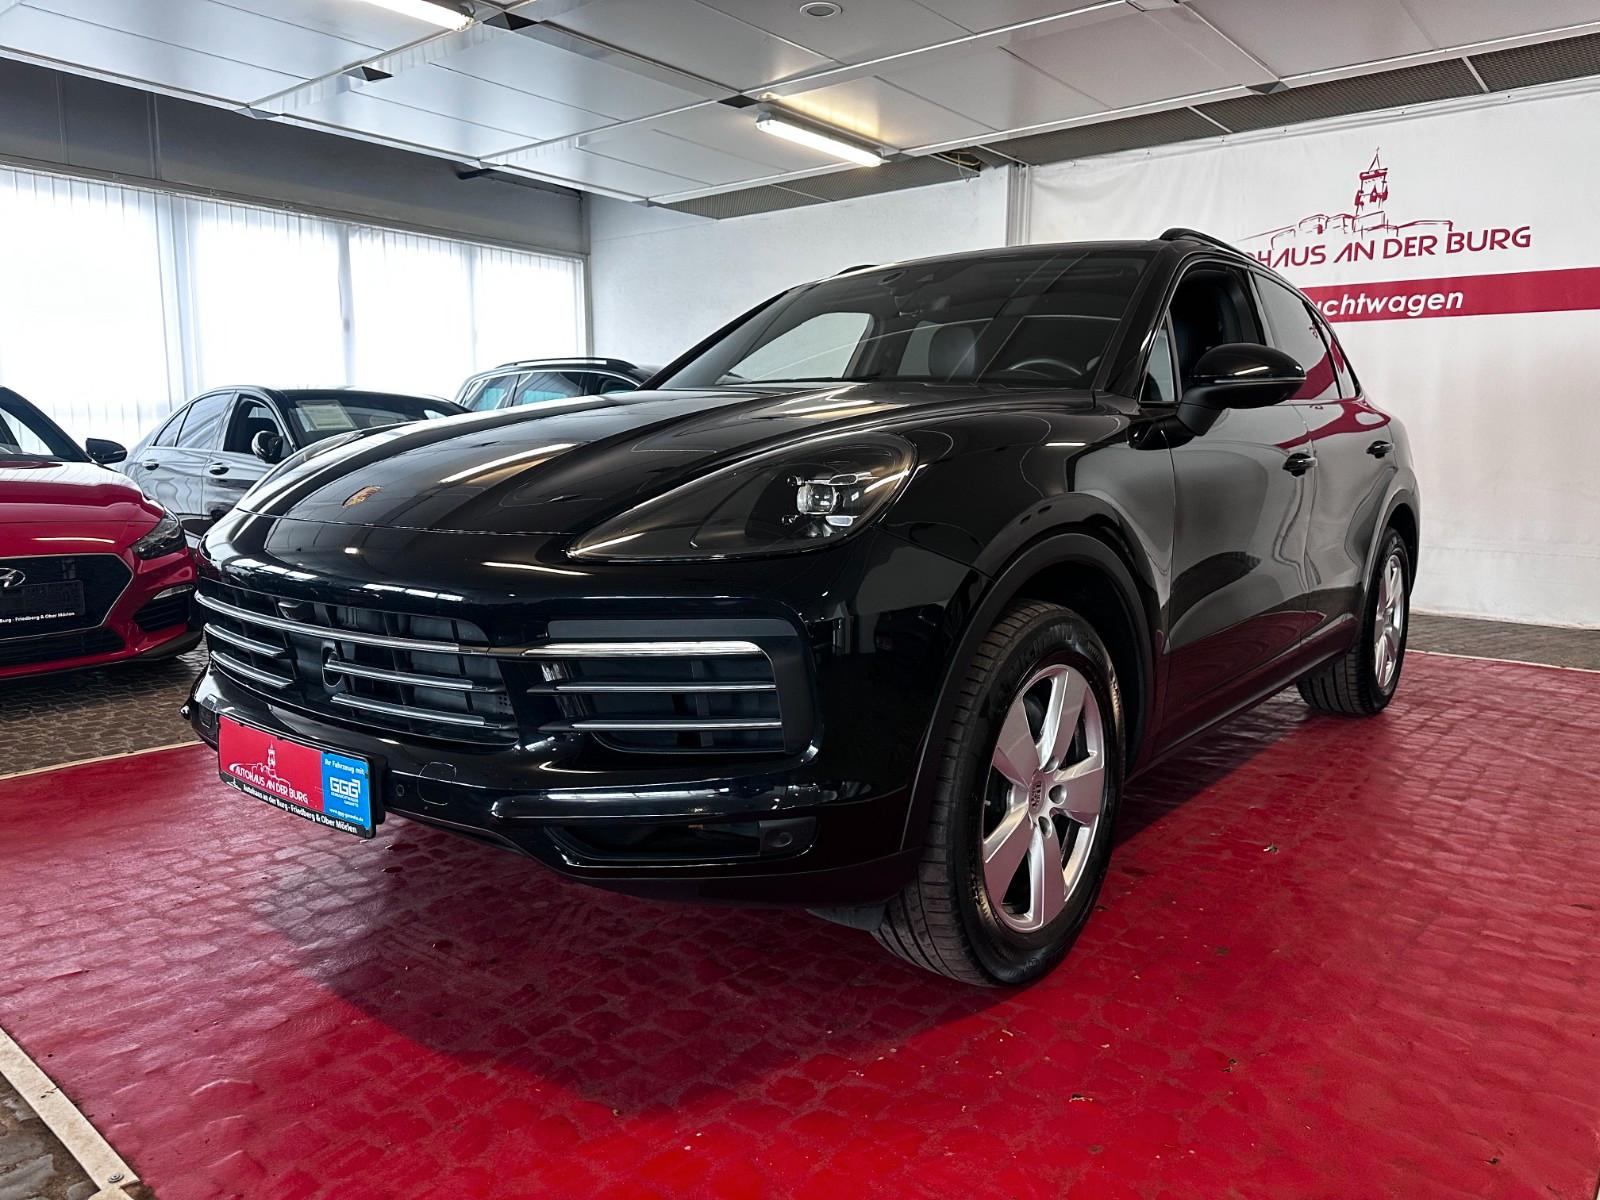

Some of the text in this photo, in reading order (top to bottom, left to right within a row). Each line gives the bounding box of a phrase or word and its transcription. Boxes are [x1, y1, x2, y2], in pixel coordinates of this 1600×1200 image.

[1246, 226, 1532, 268] HAUS AN DER BURG
[235, 766, 309, 804] AUTOHAUS AN DER BURG
[329, 776, 361, 799] GGG
[276, 799, 288, 811] Burg
[290, 804, 316, 822] Friedberg
[315, 813, 321, 822] &
[321, 815, 335, 827] Ober
[335, 820, 358, 834] Mörlen
